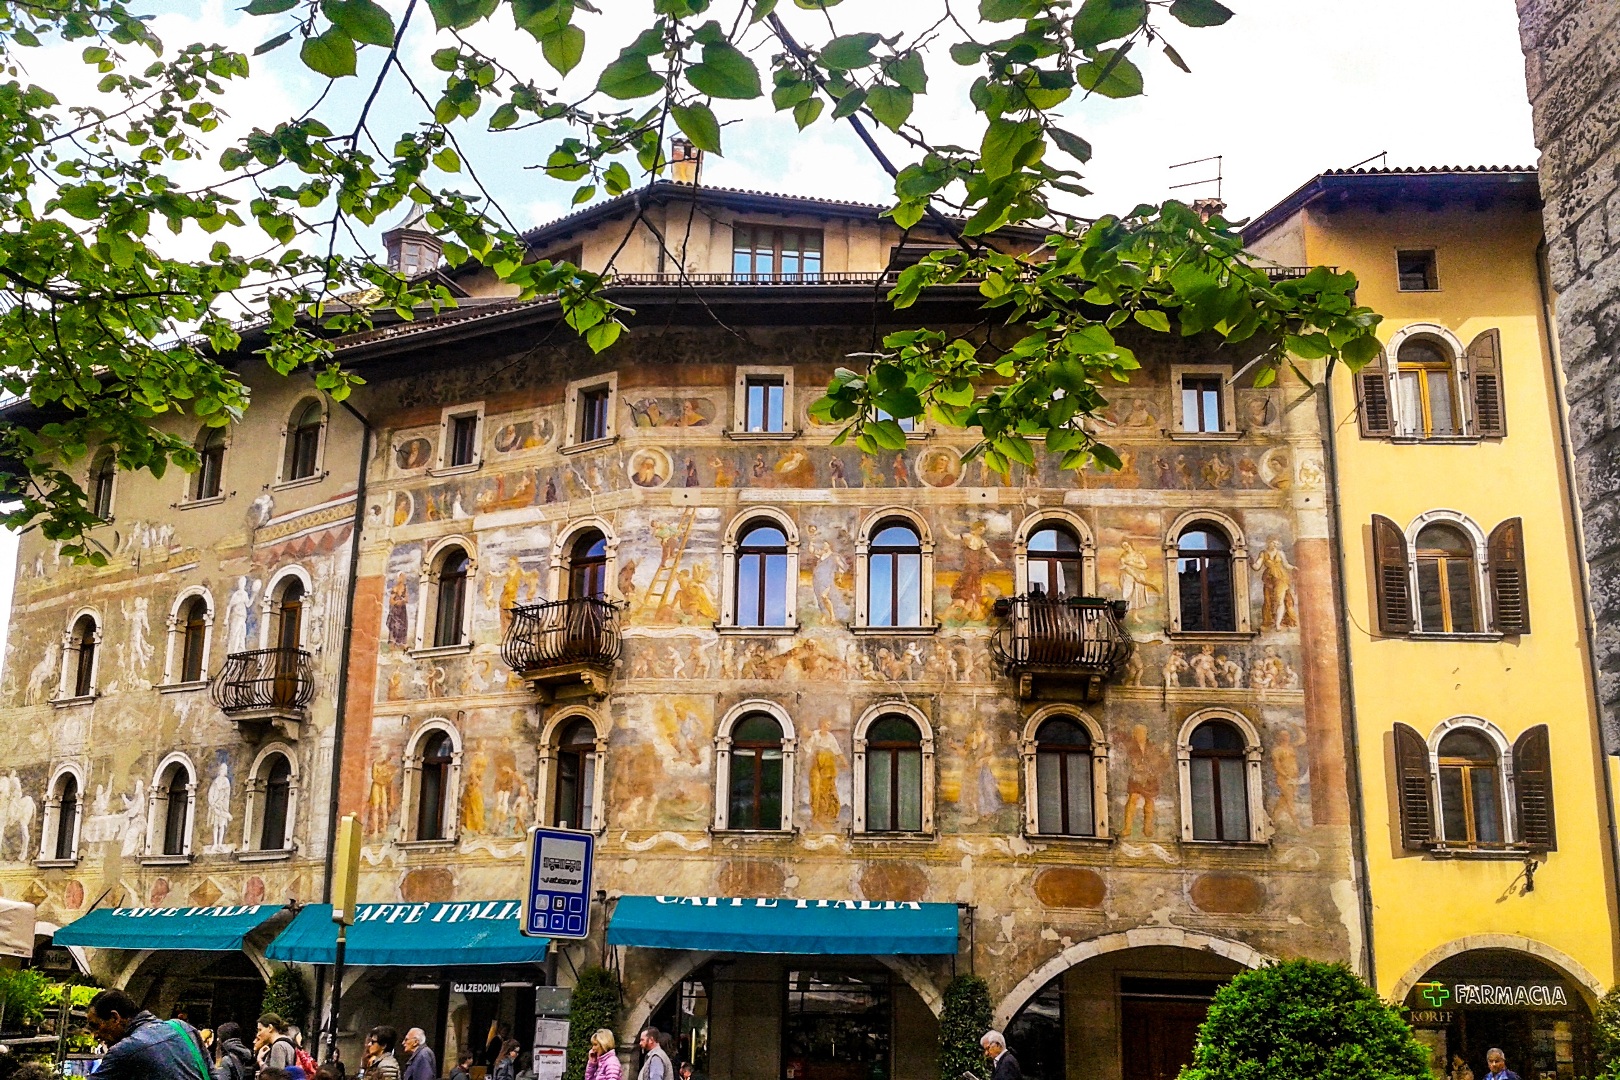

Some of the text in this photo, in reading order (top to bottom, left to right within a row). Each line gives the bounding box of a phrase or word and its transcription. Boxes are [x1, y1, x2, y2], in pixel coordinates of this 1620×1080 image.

[453, 983, 500, 993] CALZEDONIA
[1455, 984, 1568, 1006] FARMACIA
[1410, 1011, 1453, 1022] KORFF
